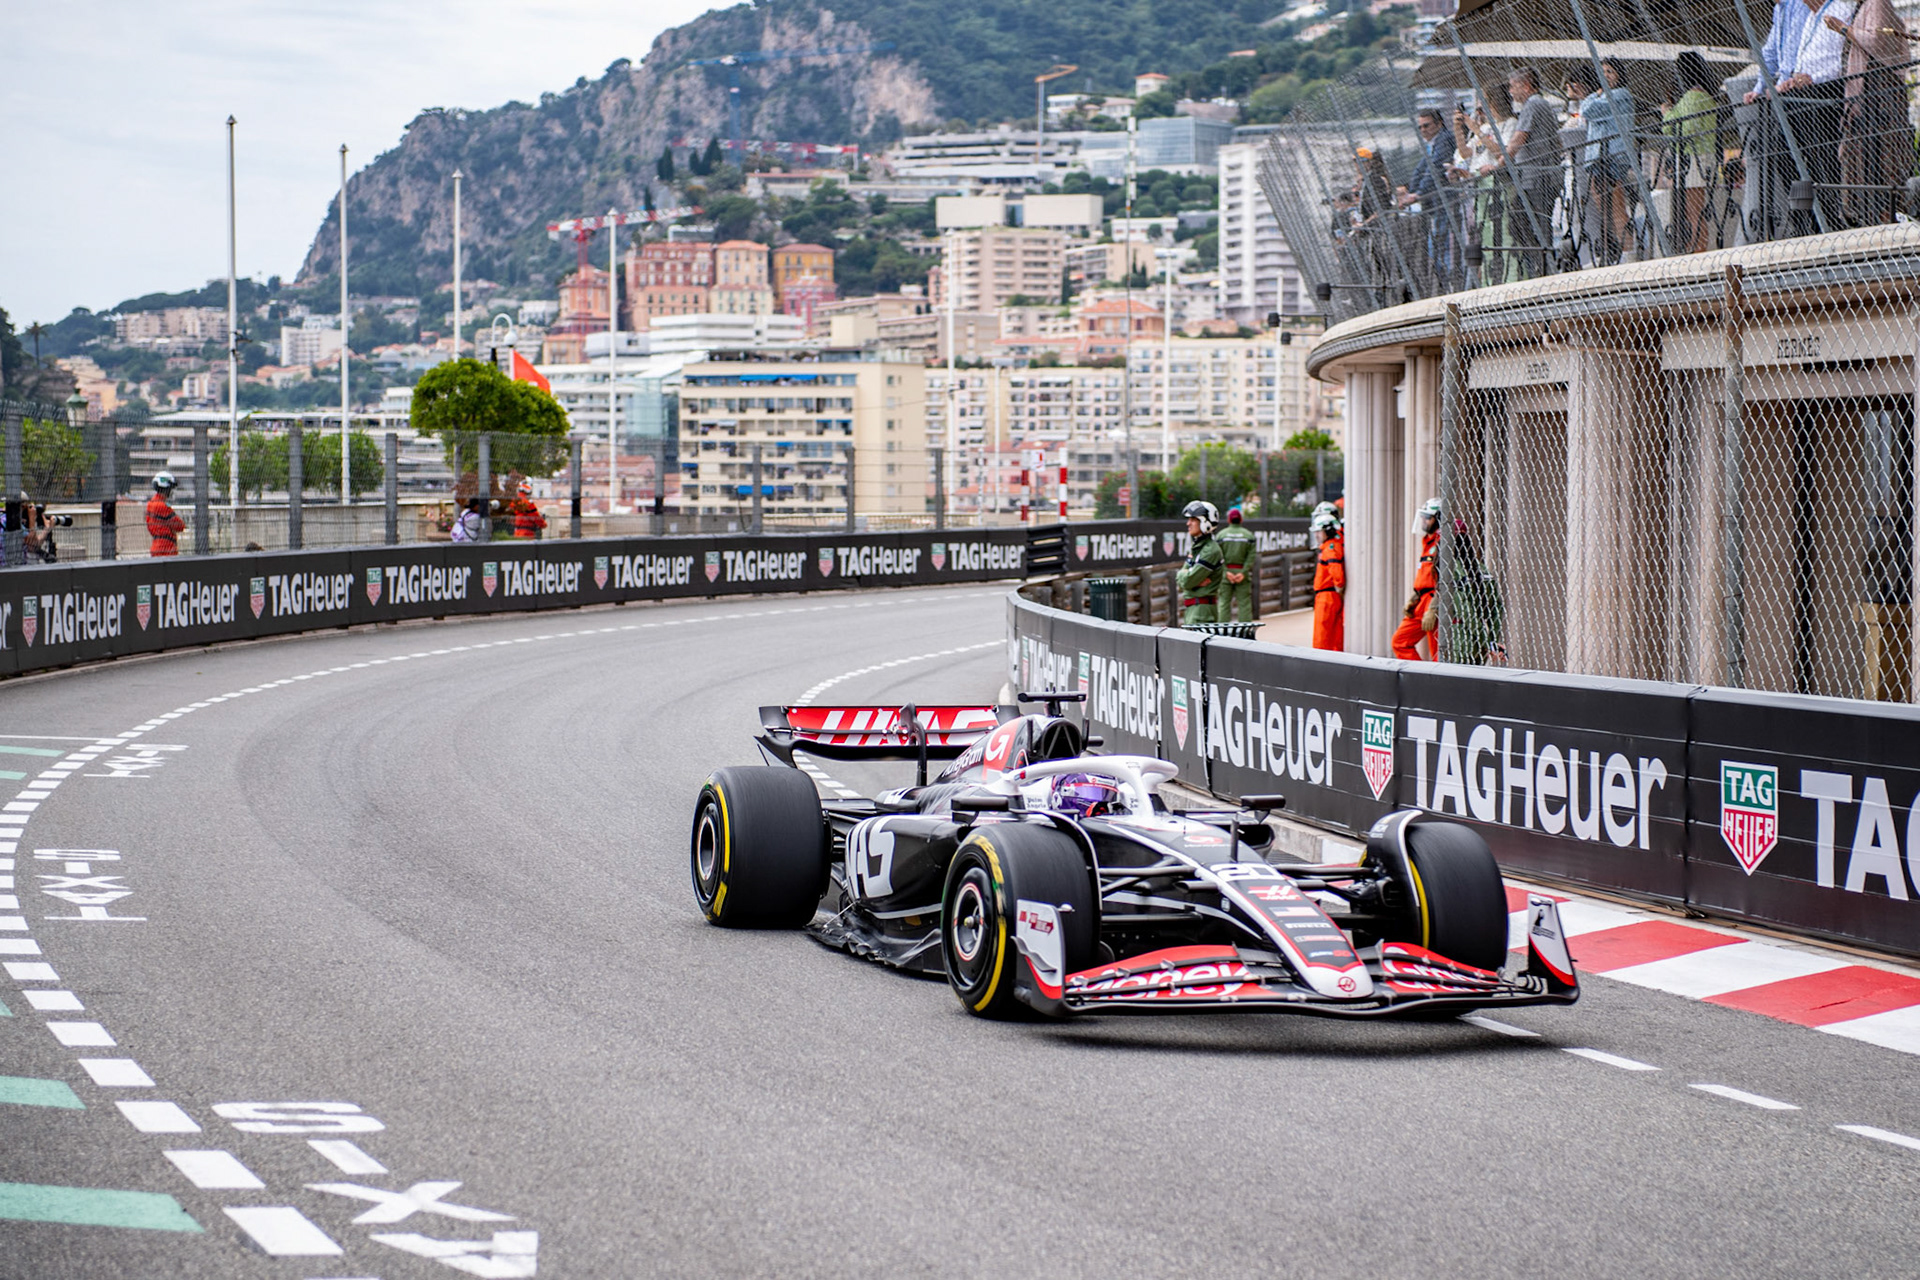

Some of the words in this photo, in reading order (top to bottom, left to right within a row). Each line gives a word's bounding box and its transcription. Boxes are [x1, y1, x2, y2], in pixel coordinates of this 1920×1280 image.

[723, 550, 807, 582] TAGHeuer
[837, 545, 922, 577] TAGHeuer
[948, 542, 1026, 571] TAGHeuer
[1090, 534, 1156, 561] TAGHeuer
[385, 564, 471, 604] TAGHeuer
[501, 560, 583, 597] TAGHeuer
[611, 554, 694, 589] TAGHeuer
[154, 581, 239, 629] TAGHeuer
[268, 572, 354, 617] TAGHeuer
[41, 592, 126, 645] TAGHeuer
[1091, 655, 1165, 741] TAGHeuer
[1190, 680, 1343, 787] TAGHeuer
[1365, 716, 1391, 745] TAG
[1364, 750, 1392, 794] HEUER
[1407, 715, 1668, 850] TAGHeuer
[1726, 769, 1773, 807] TAG
[1724, 811, 1774, 866] HEUER
[1800, 769, 1920, 901] TA
[211, 1101, 539, 1279] AXIS
